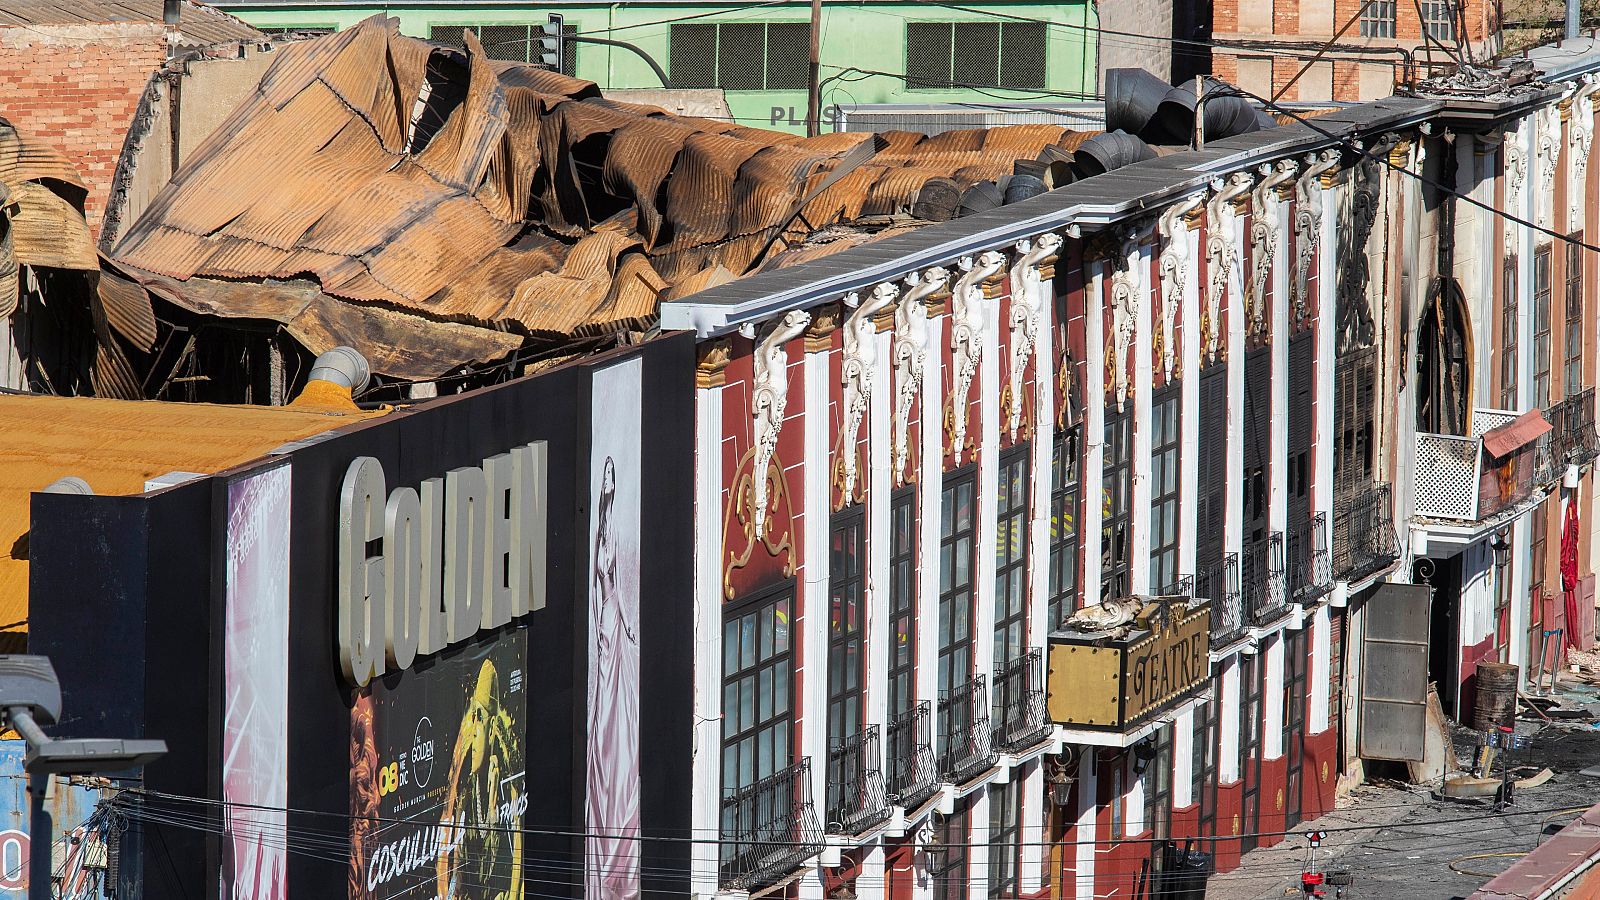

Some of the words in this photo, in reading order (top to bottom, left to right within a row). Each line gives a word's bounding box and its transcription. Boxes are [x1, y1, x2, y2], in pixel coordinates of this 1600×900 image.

[771, 106, 835, 125] PLS
[339, 440, 548, 687] GOLDEN
[1134, 632, 1201, 710] TEATRE
[412, 740, 434, 763] GOLDEN
[379, 761, 399, 797] 08
